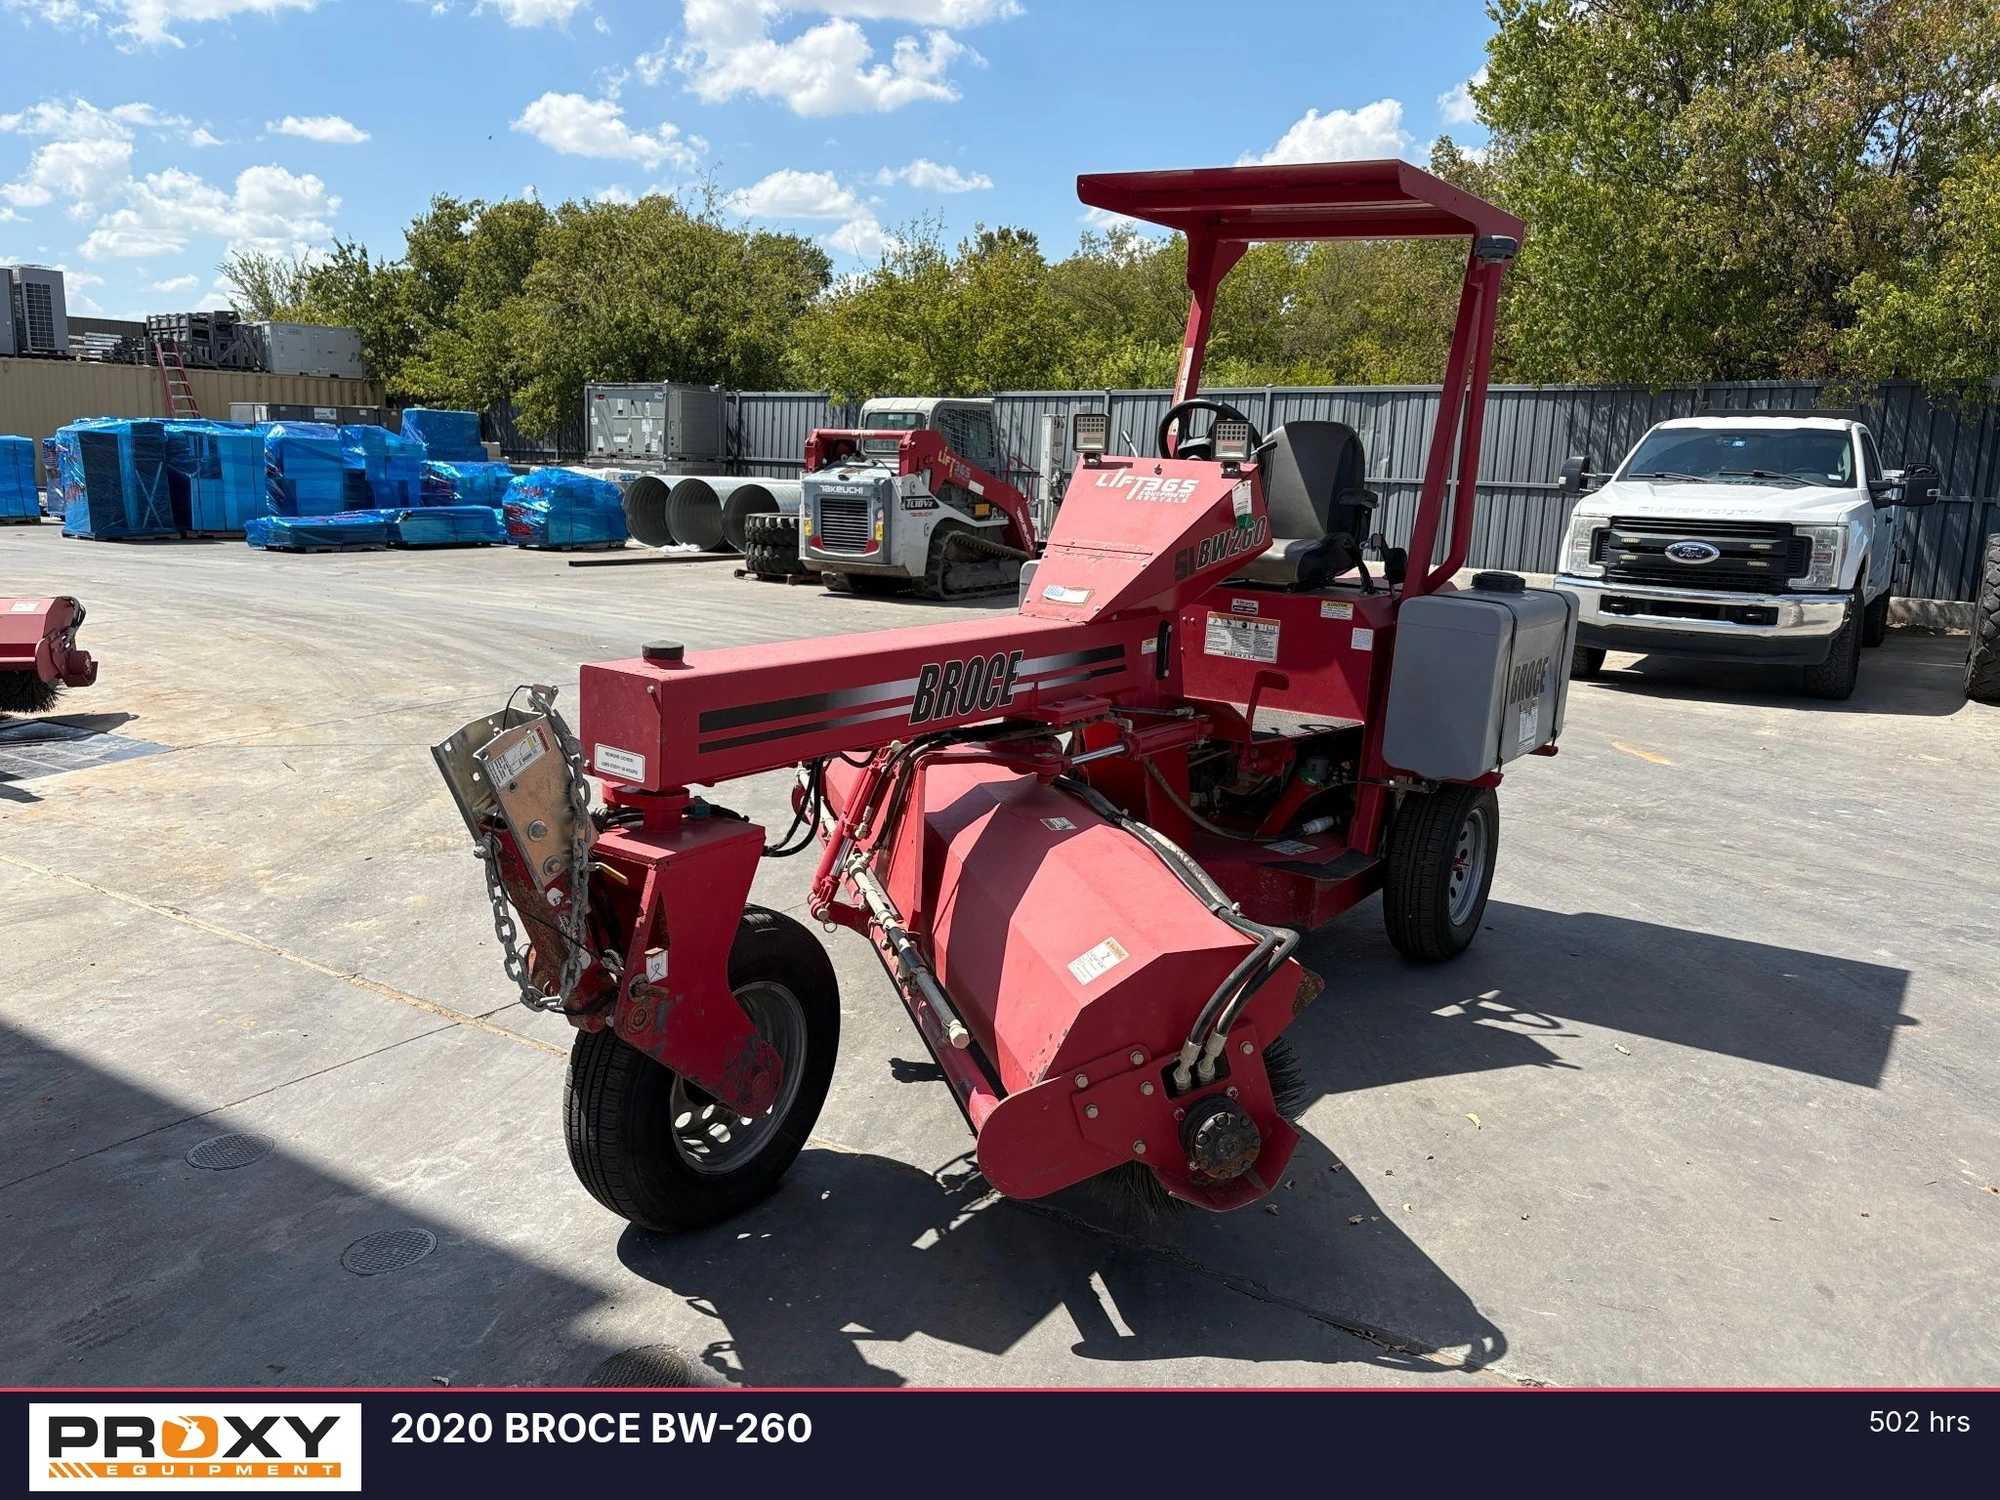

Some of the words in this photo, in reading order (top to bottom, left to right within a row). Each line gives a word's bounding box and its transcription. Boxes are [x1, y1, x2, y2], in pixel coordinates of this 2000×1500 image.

[819, 484, 864, 495] TAKEUCHI
[1139, 490, 1193, 499] EQUIPMENT
[1196, 515, 1268, 570] BW260
[1678, 546, 1706, 559] Ford
[907, 649, 1025, 727] BROCE
[1508, 655, 1550, 706] BROCE
